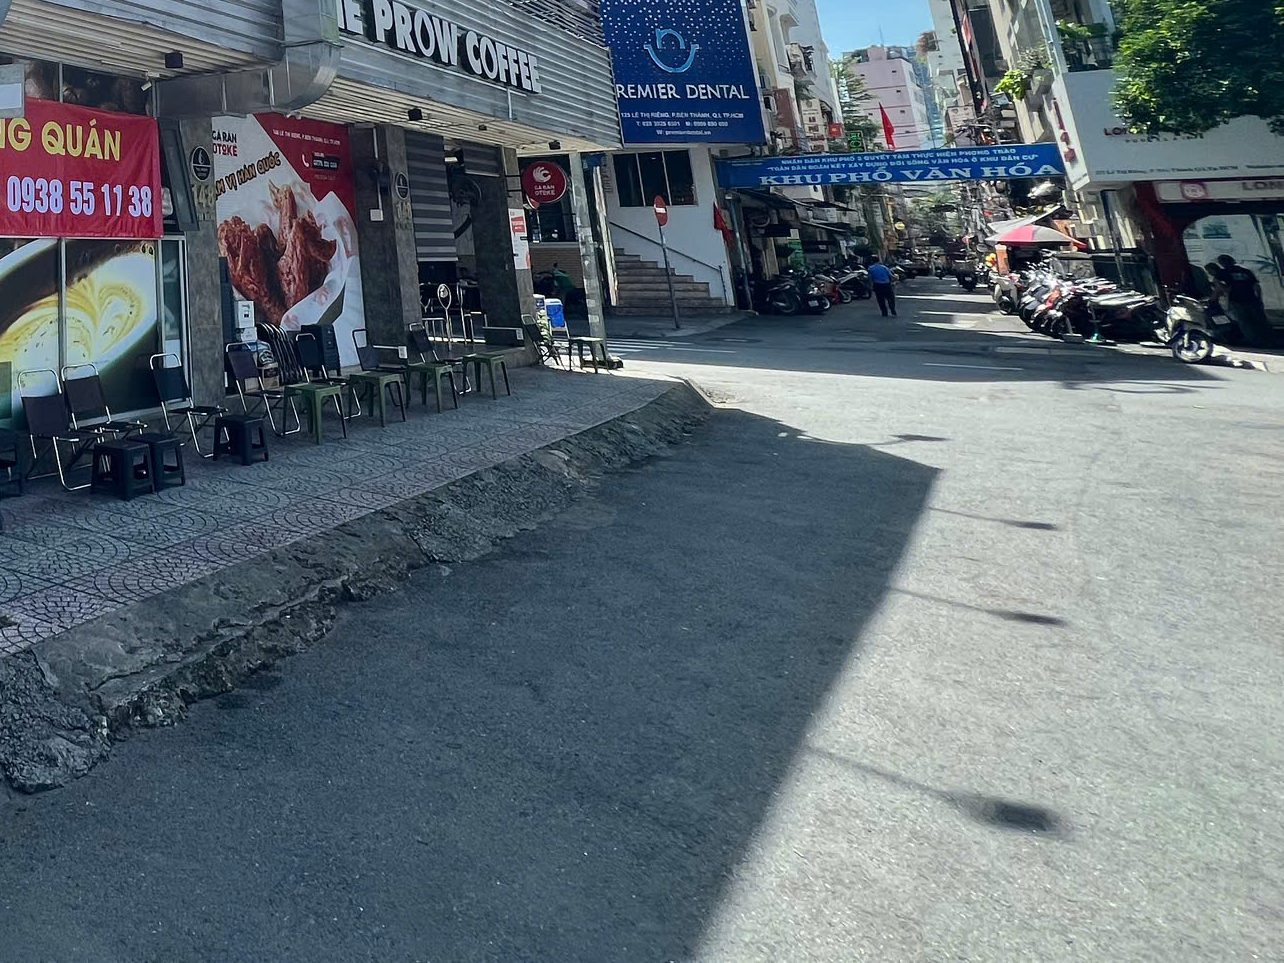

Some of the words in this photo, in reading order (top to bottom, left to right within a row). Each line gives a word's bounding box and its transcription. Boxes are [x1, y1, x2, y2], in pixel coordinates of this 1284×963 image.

[465, 30, 542, 94] COFFEE
[615, 83, 681, 100] REMIER
[686, 84, 750, 100] DENTAL
[41, 118, 123, 162] QUÁN
[759, 172, 823, 186] KHU
[829, 166, 893, 184] PHỐ
[900, 166, 972, 181] VĂN
[980, 162, 1064, 177] HÓA
[6, 175, 64, 214] 0938
[69, 180, 96, 216] 55
[100, 183, 123, 217] 11
[128, 185, 153, 218] 38
